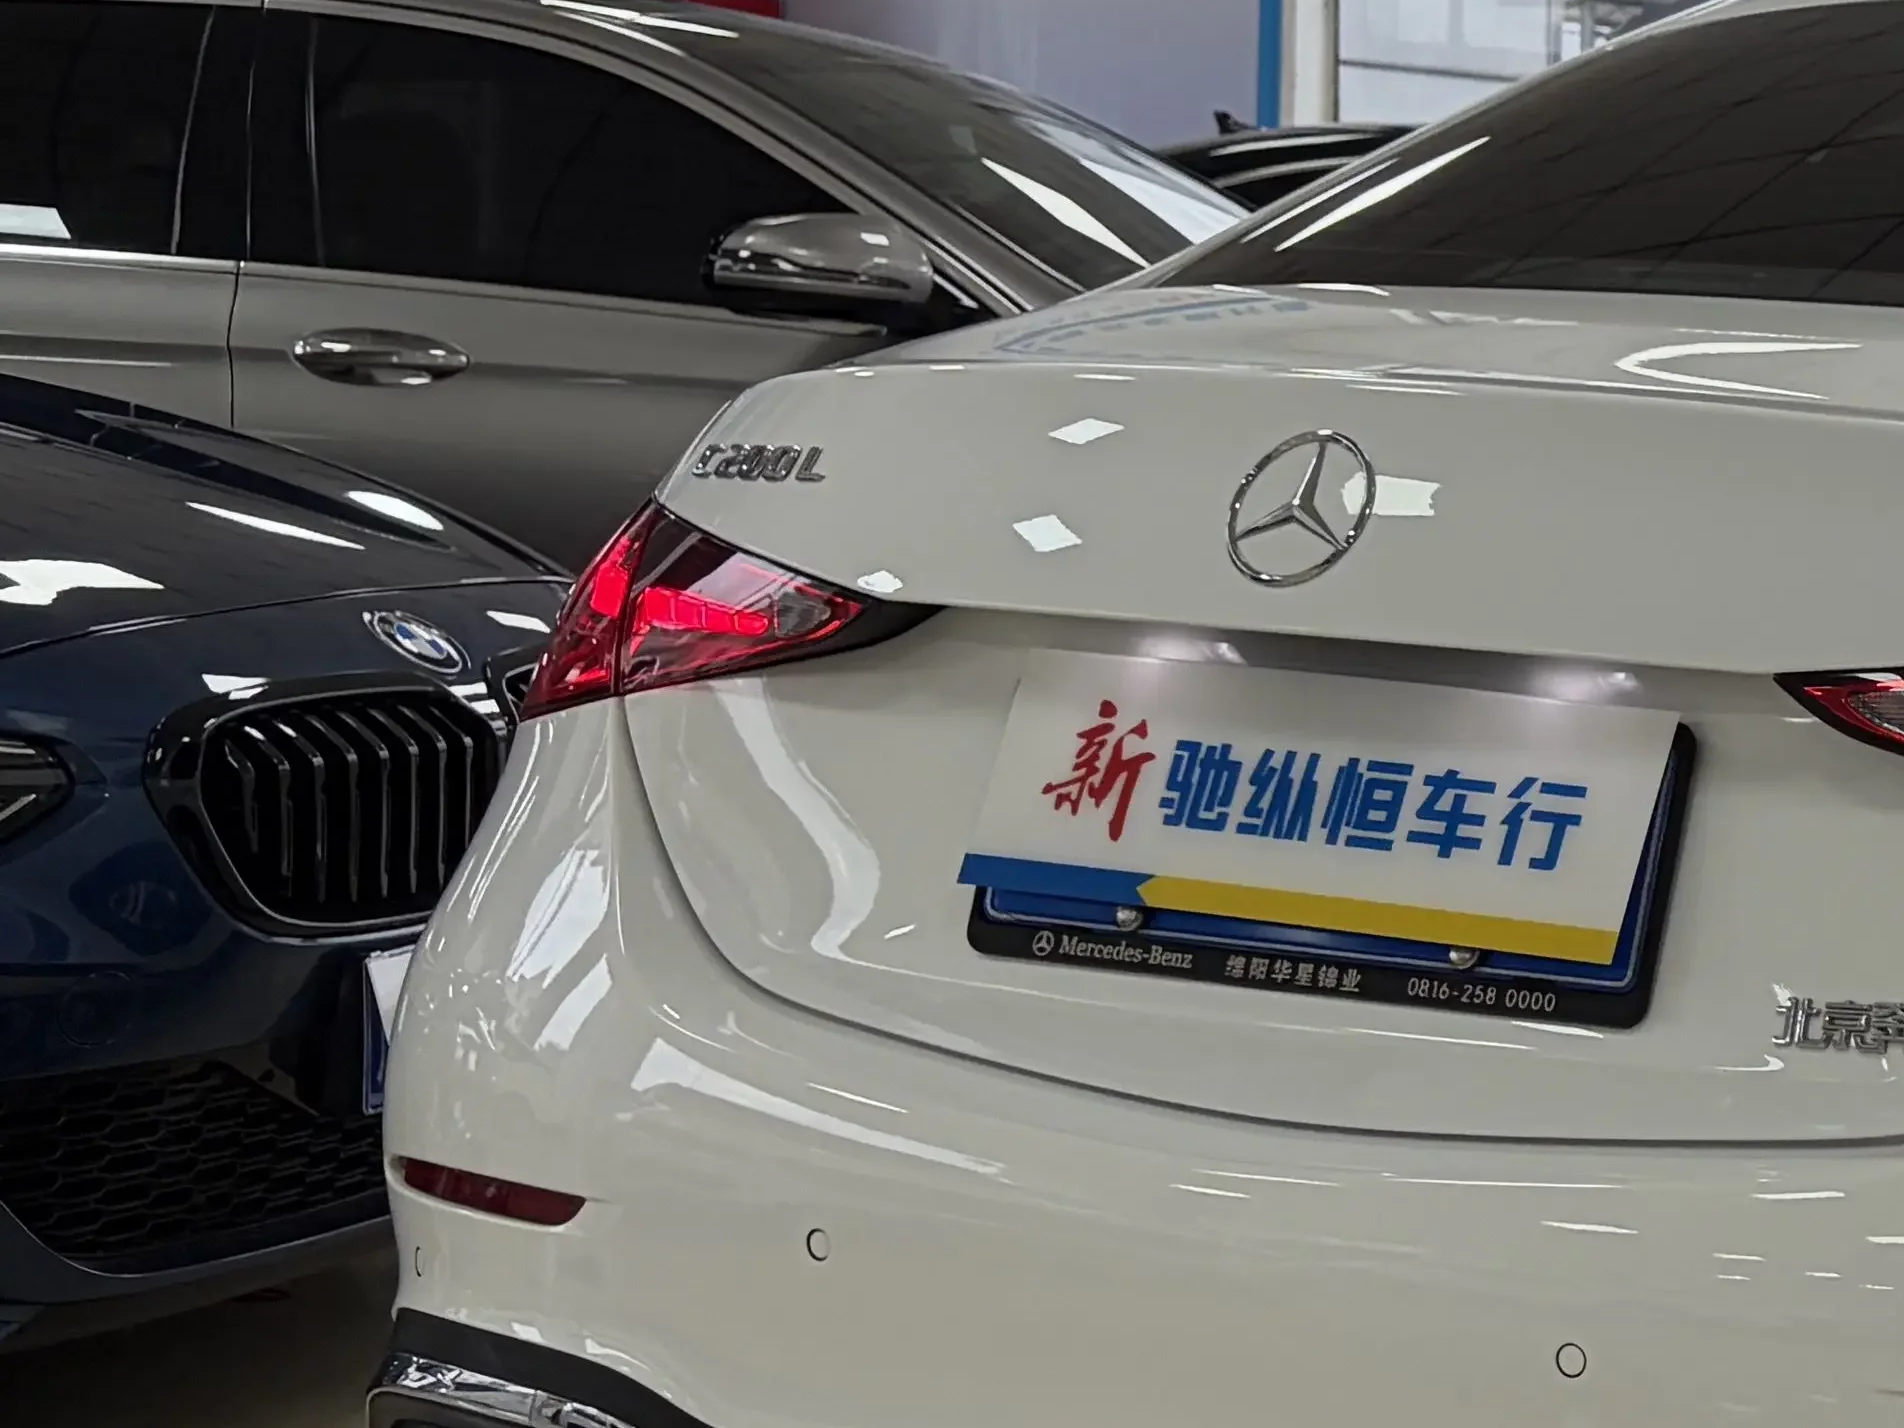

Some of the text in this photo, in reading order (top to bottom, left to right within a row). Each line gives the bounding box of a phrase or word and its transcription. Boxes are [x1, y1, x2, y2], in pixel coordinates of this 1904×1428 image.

[1042, 700, 1588, 872] 新驰纵恒车行
[1058, 933, 1193, 970] Mercedes-Benz
[1406, 976, 1497, 1007] 0816-258
[1504, 989, 1556, 1013] 0000
